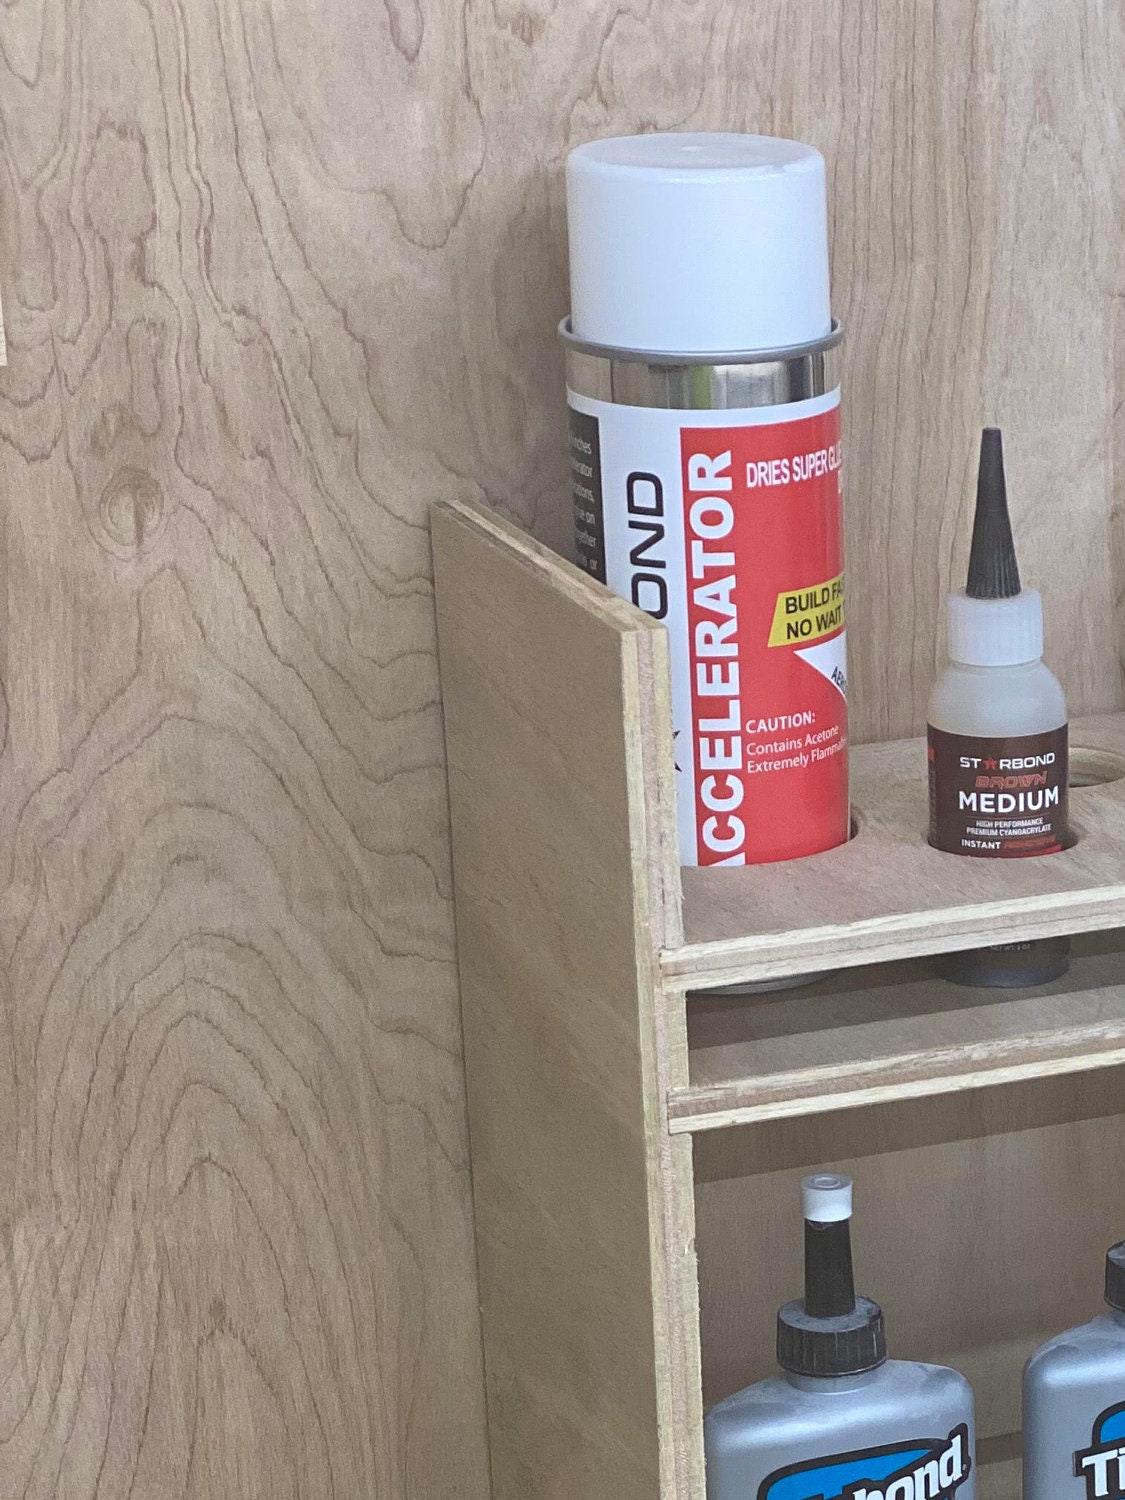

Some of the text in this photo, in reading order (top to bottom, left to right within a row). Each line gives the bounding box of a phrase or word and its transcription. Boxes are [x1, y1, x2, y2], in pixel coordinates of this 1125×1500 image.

[746, 457, 790, 489] DRIES
[792, 449, 828, 482] SUPER
[785, 587, 830, 615] BUILD
[786, 618, 813, 641] NO
[816, 606, 842, 632] WAIT
[745, 710, 816, 734] CAUTION:
[746, 725, 840, 756] Contains Acetone
[747, 752, 809, 774] Extremely
[975, 770, 1048, 790] BROWN
[958, 785, 1059, 813] MEDIUM
[966, 823, 1052, 837] PREMIUM CYANOACRYLATE
[976, 817, 1044, 828] HIGH PERFORMANCE
[961, 838, 1002, 850] INSTANT
